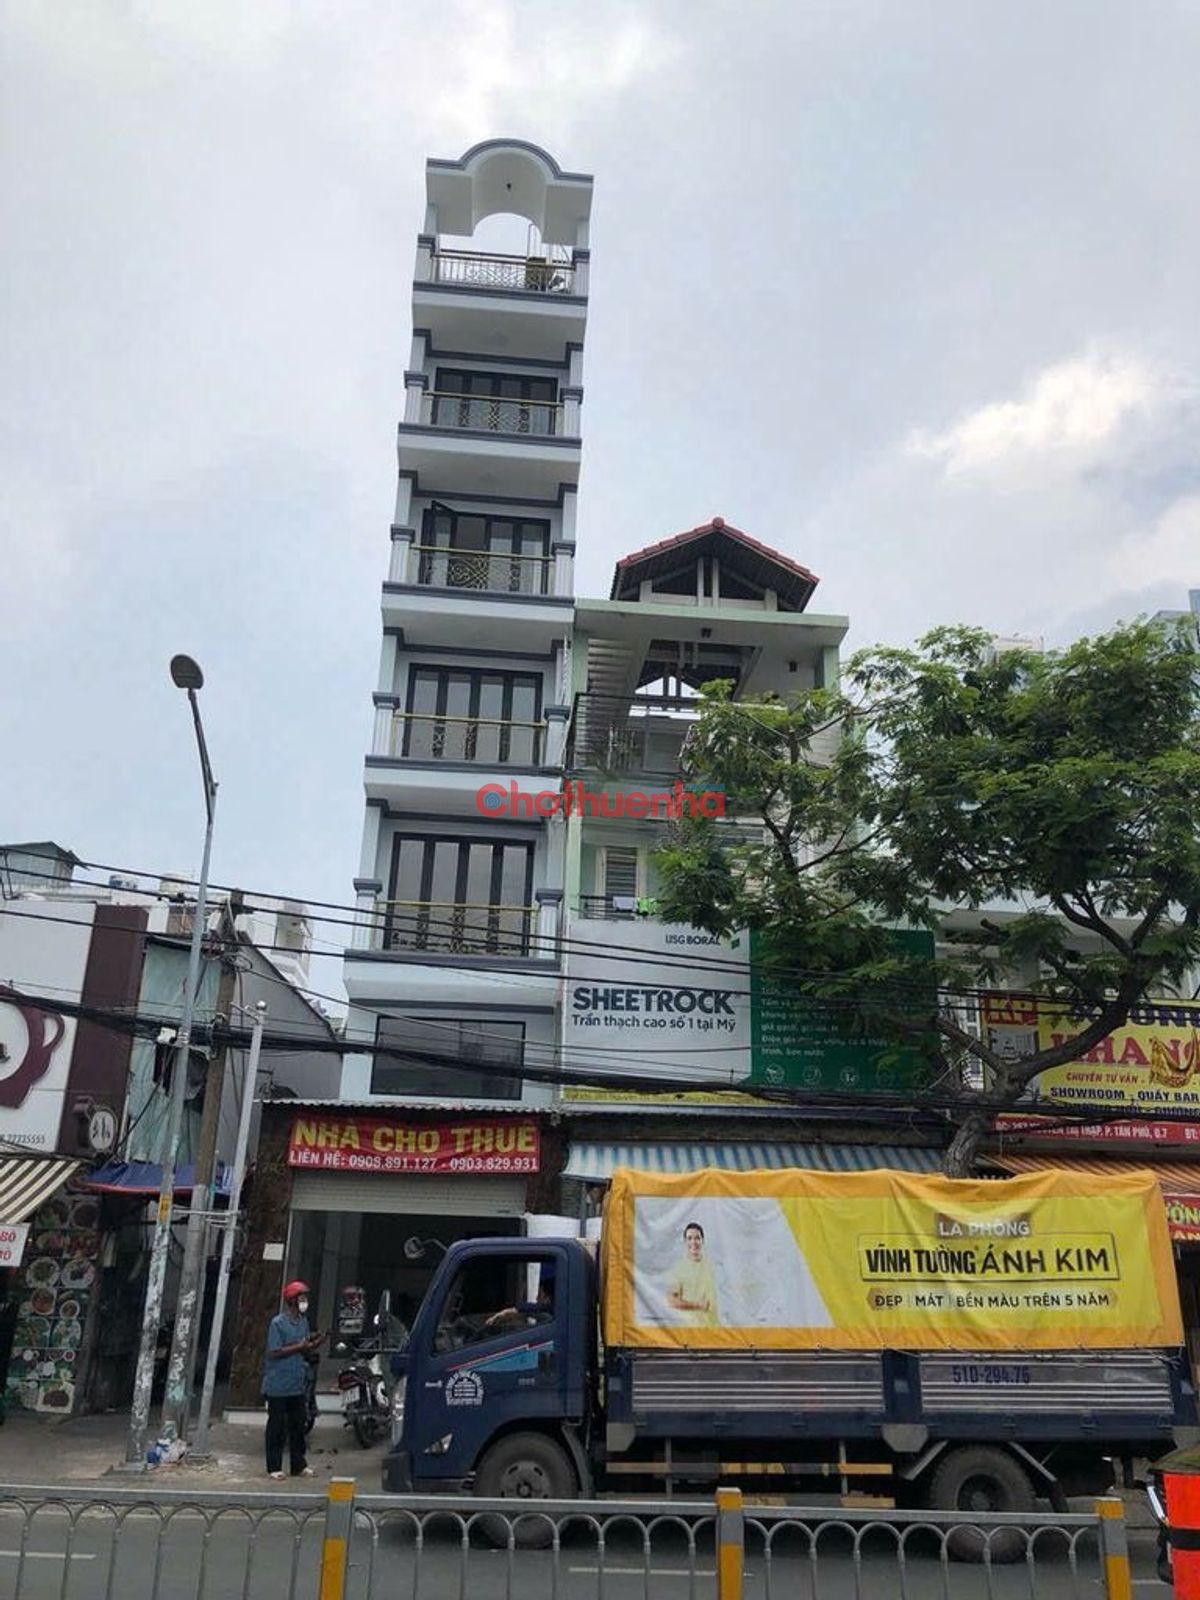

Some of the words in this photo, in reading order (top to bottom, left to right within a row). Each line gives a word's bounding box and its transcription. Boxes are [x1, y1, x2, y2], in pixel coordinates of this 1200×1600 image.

[665, 935, 686, 945] USG
[572, 987, 736, 1015] SHEETROCK
[643, 1018, 667, 1029] cao
[688, 1017, 694, 1029] 1
[1050, 1087, 1125, 1099] SHOWROOM
[1174, 1092, 1200, 1103] BAR
[372, 1127, 441, 1153] CHO
[451, 1120, 536, 1153] THUÊ
[289, 1148, 319, 1165] LIÊN
[939, 1221, 963, 1237] LA
[865, 1243, 912, 1273] VĨNH
[981, 1243, 1047, 1274] ÁNH
[1055, 1247, 1110, 1272] KIM
[915, 1292, 945, 1307] MÁT
[987, 1293, 1020, 1308] MÀU
[1024, 1292, 1061, 1308] TRÊN
[1065, 1295, 1074, 1306] 5
[1077, 1291, 1110, 1306] NĂM
